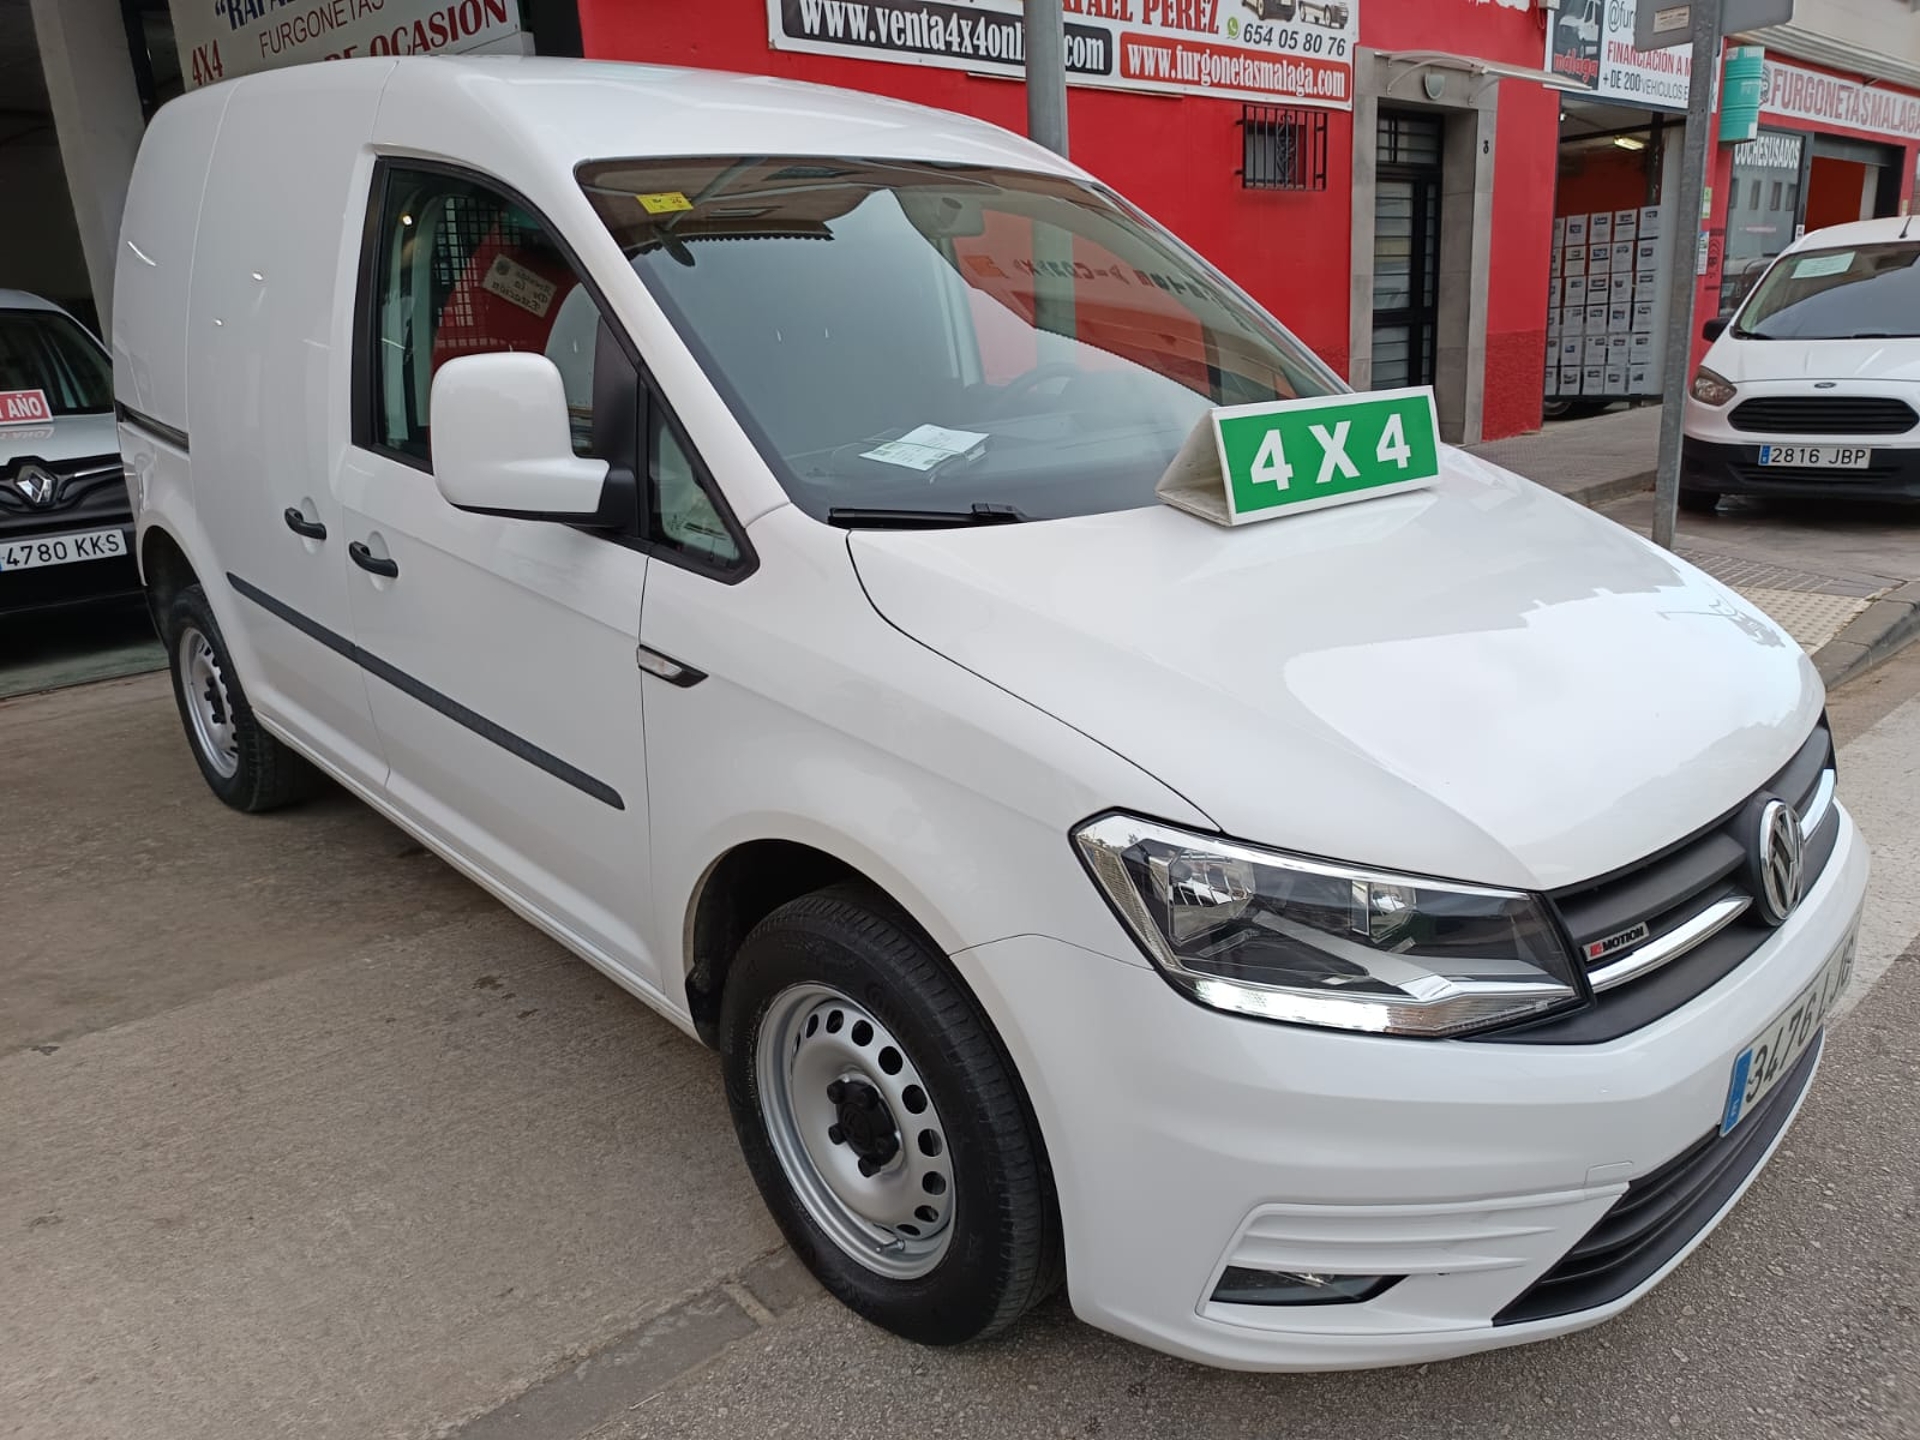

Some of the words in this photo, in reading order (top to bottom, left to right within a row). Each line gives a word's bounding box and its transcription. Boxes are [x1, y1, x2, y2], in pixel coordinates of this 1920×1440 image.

[1244, 23, 1273, 46] 654
[1279, 29, 1299, 50] 05
[1303, 33, 1322, 53] 80
[1328, 36, 1346, 57] 76
[192, 38, 223, 86] 4X4
[1127, 44, 1345, 98] www.furgonetasmalaga.com
[1676, 57, 1682, 77] A
[1610, 69, 1622, 89] DE
[1624, 73, 1640, 92] 200
[7, 394, 42, 418] AÑO
[1250, 429, 1294, 491] 4
[1308, 420, 1361, 484] X
[1376, 413, 1412, 469] 4
[1771, 447, 1820, 464] 2816
[1828, 449, 1867, 465] JBP
[6, 541, 67, 567] 4780
[74, 533, 120, 558] KKS
[1746, 992, 1817, 1104] 3476
